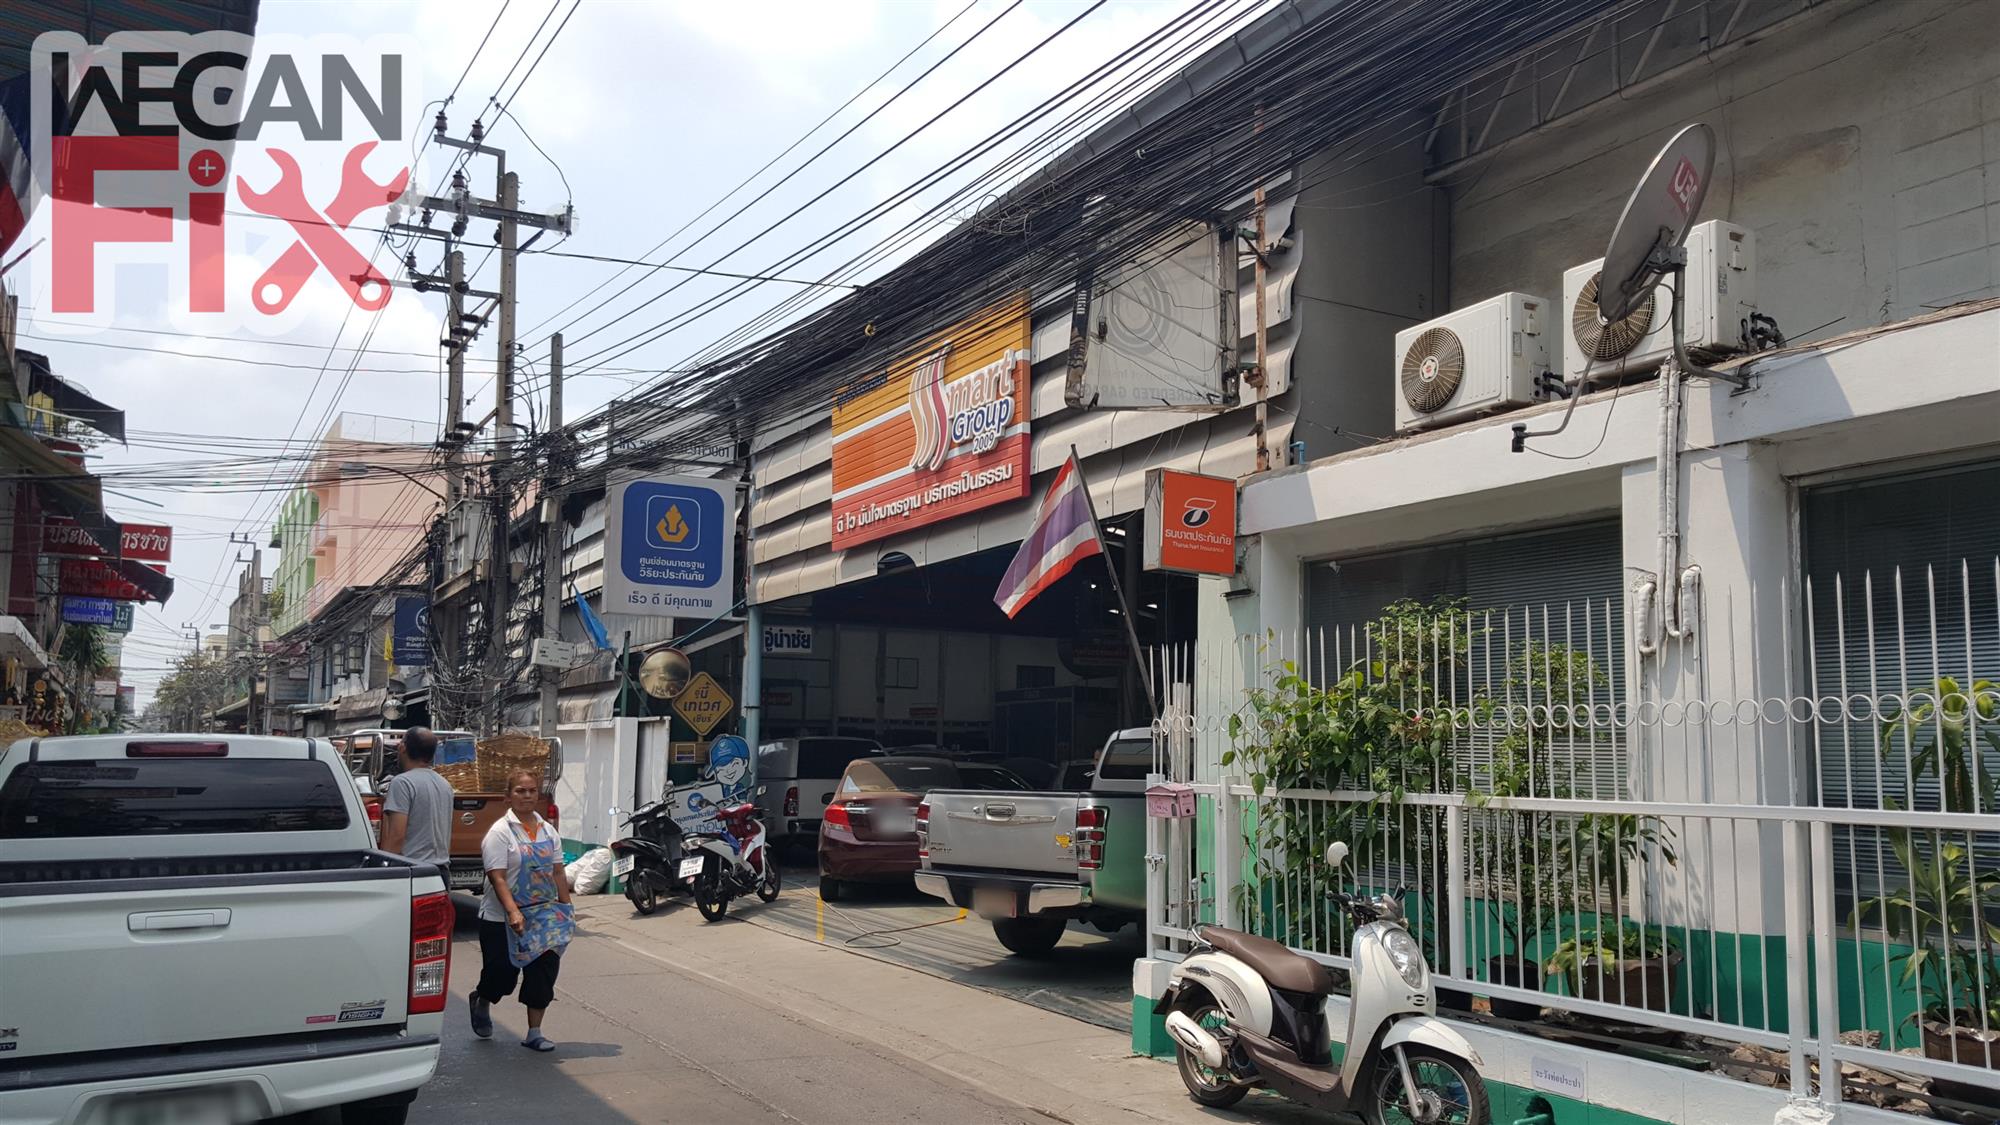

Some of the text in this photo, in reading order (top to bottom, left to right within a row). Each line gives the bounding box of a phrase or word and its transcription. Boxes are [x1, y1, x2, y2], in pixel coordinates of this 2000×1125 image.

[952, 398, 1011, 442] Group
[973, 431, 996, 453] 2009
[836, 515, 844, 532] ดี
[1165, 529, 1232, 545] ธนชาตประกันภัย
[639, 567, 705, 581] วิริยะประกันภัย
[628, 590, 713, 610] เร็ว ดี มีคุณภาพ
[764, 627, 811, 652] อู่นำชัย
